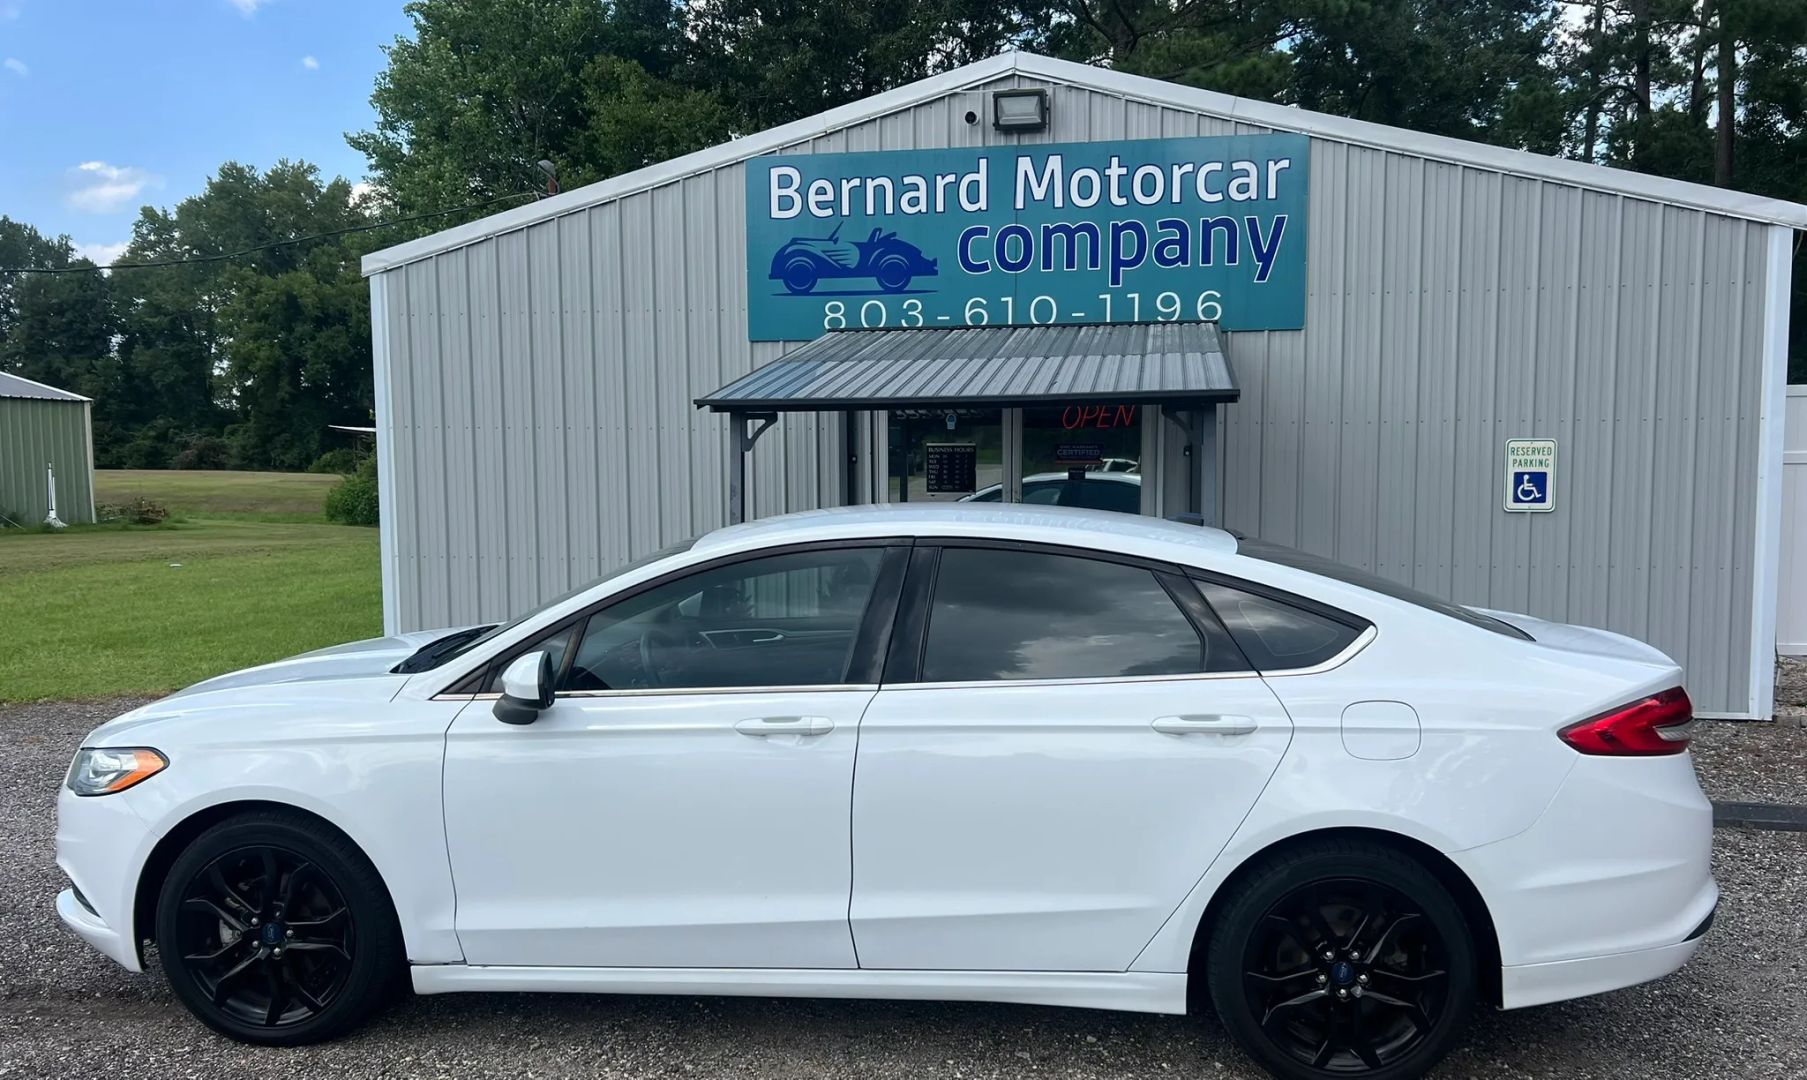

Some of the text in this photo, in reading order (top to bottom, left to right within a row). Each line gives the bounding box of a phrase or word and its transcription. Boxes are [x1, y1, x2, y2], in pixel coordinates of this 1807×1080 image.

[769, 153, 1291, 220] Bernard Motorcar
[957, 213, 1289, 288] company
[824, 290, 1224, 330] 803-610-1196
[1063, 404, 1136, 429] OPEN
[1510, 446, 1552, 456] RESERVED
[1512, 458, 1550, 468] PARKING
